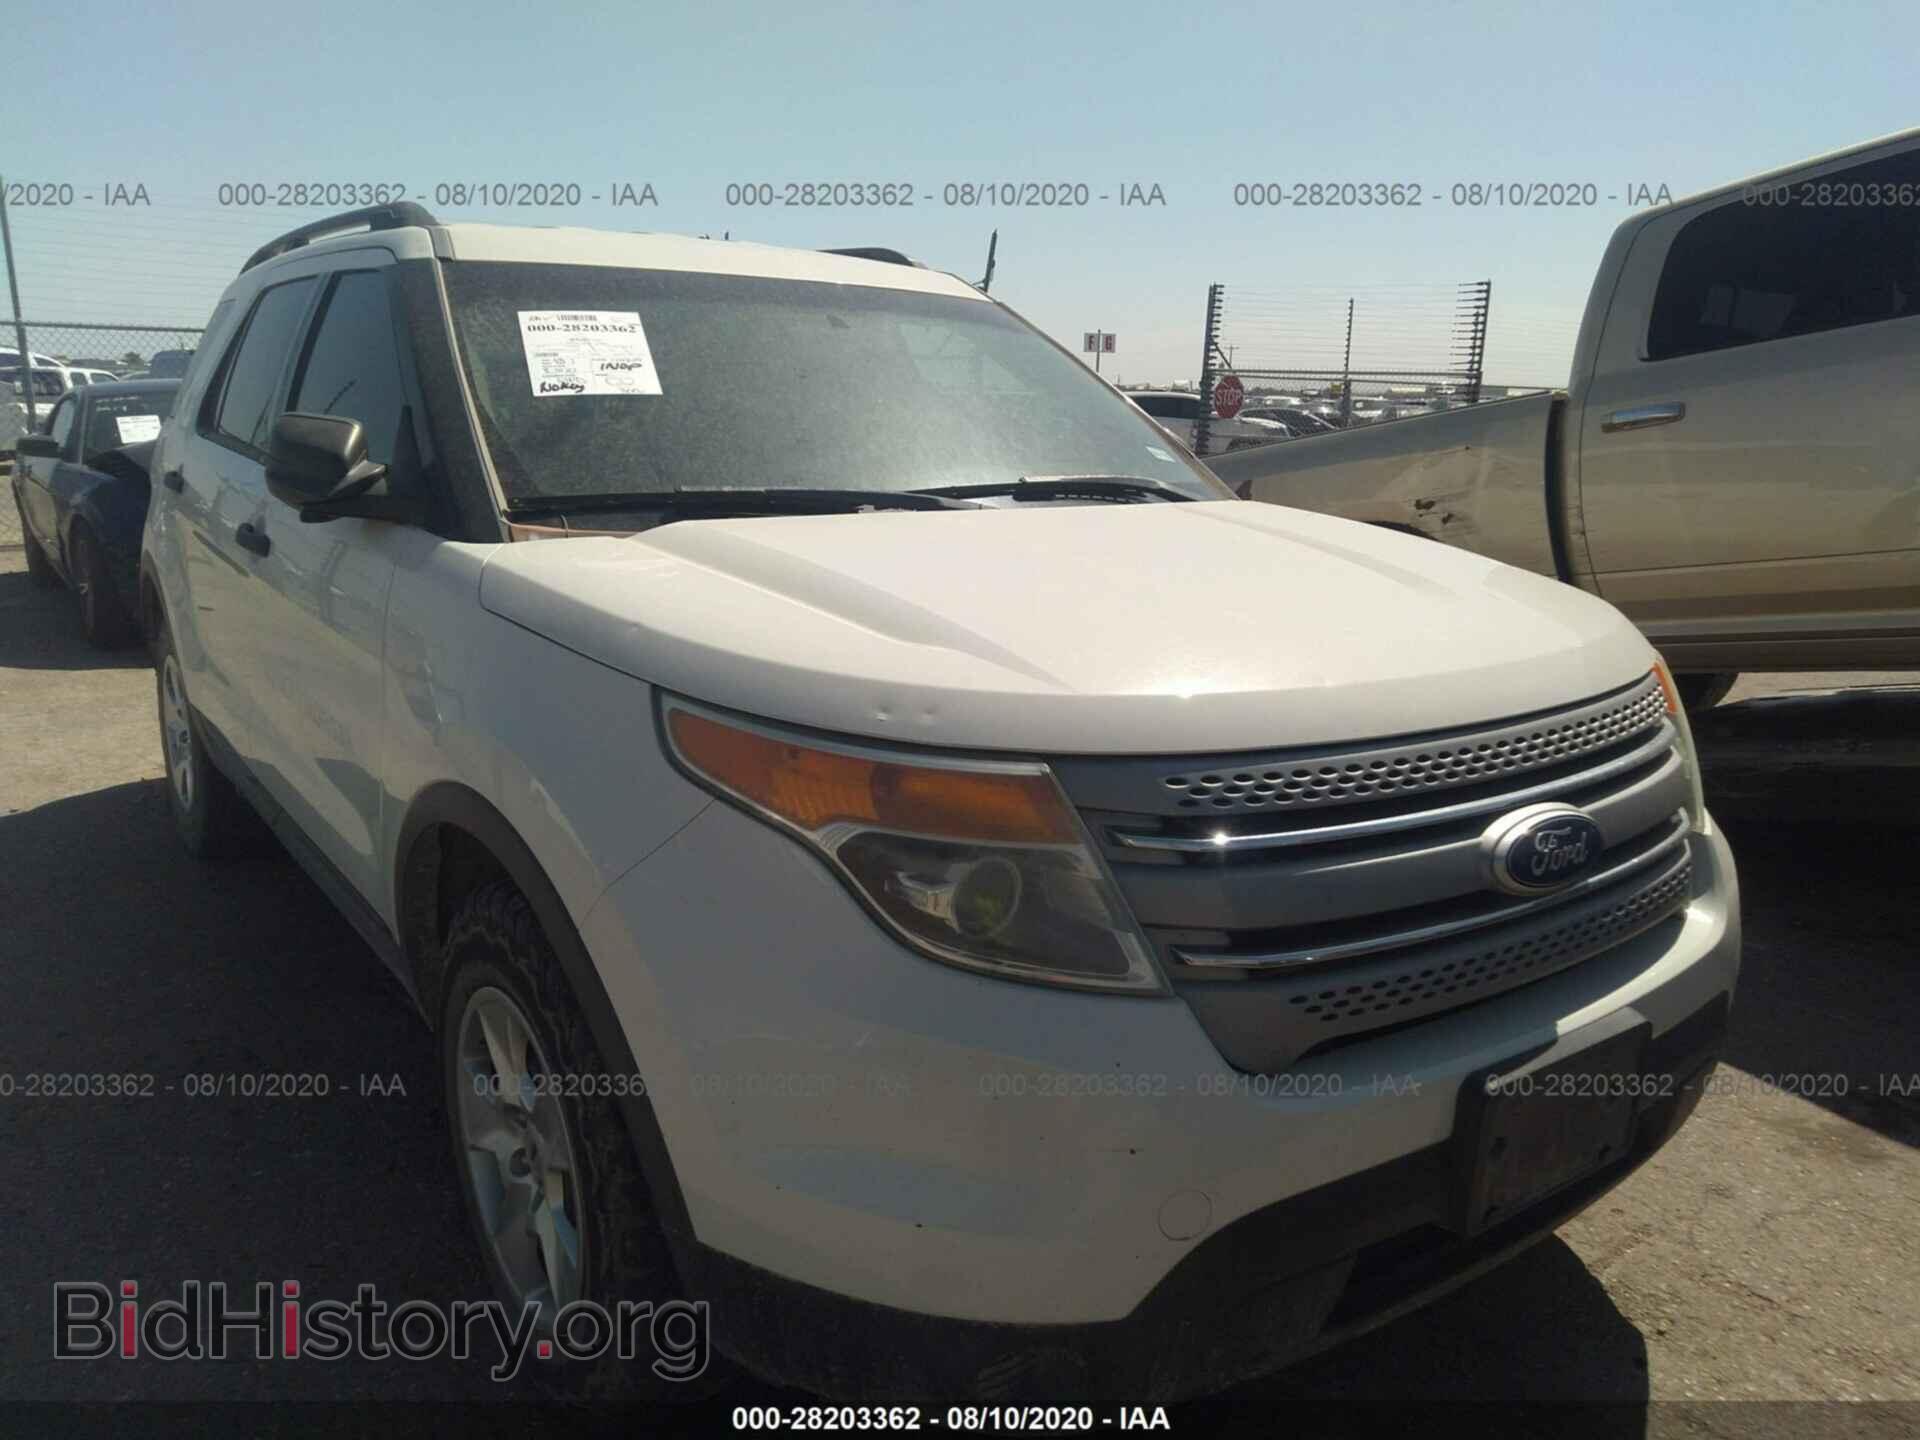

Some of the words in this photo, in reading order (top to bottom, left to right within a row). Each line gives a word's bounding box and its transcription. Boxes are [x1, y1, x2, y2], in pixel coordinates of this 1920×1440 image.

[527, 323, 637, 333] 000-28203362
[1215, 389, 1242, 407] STOP
[1531, 826, 1588, 876] Ford
